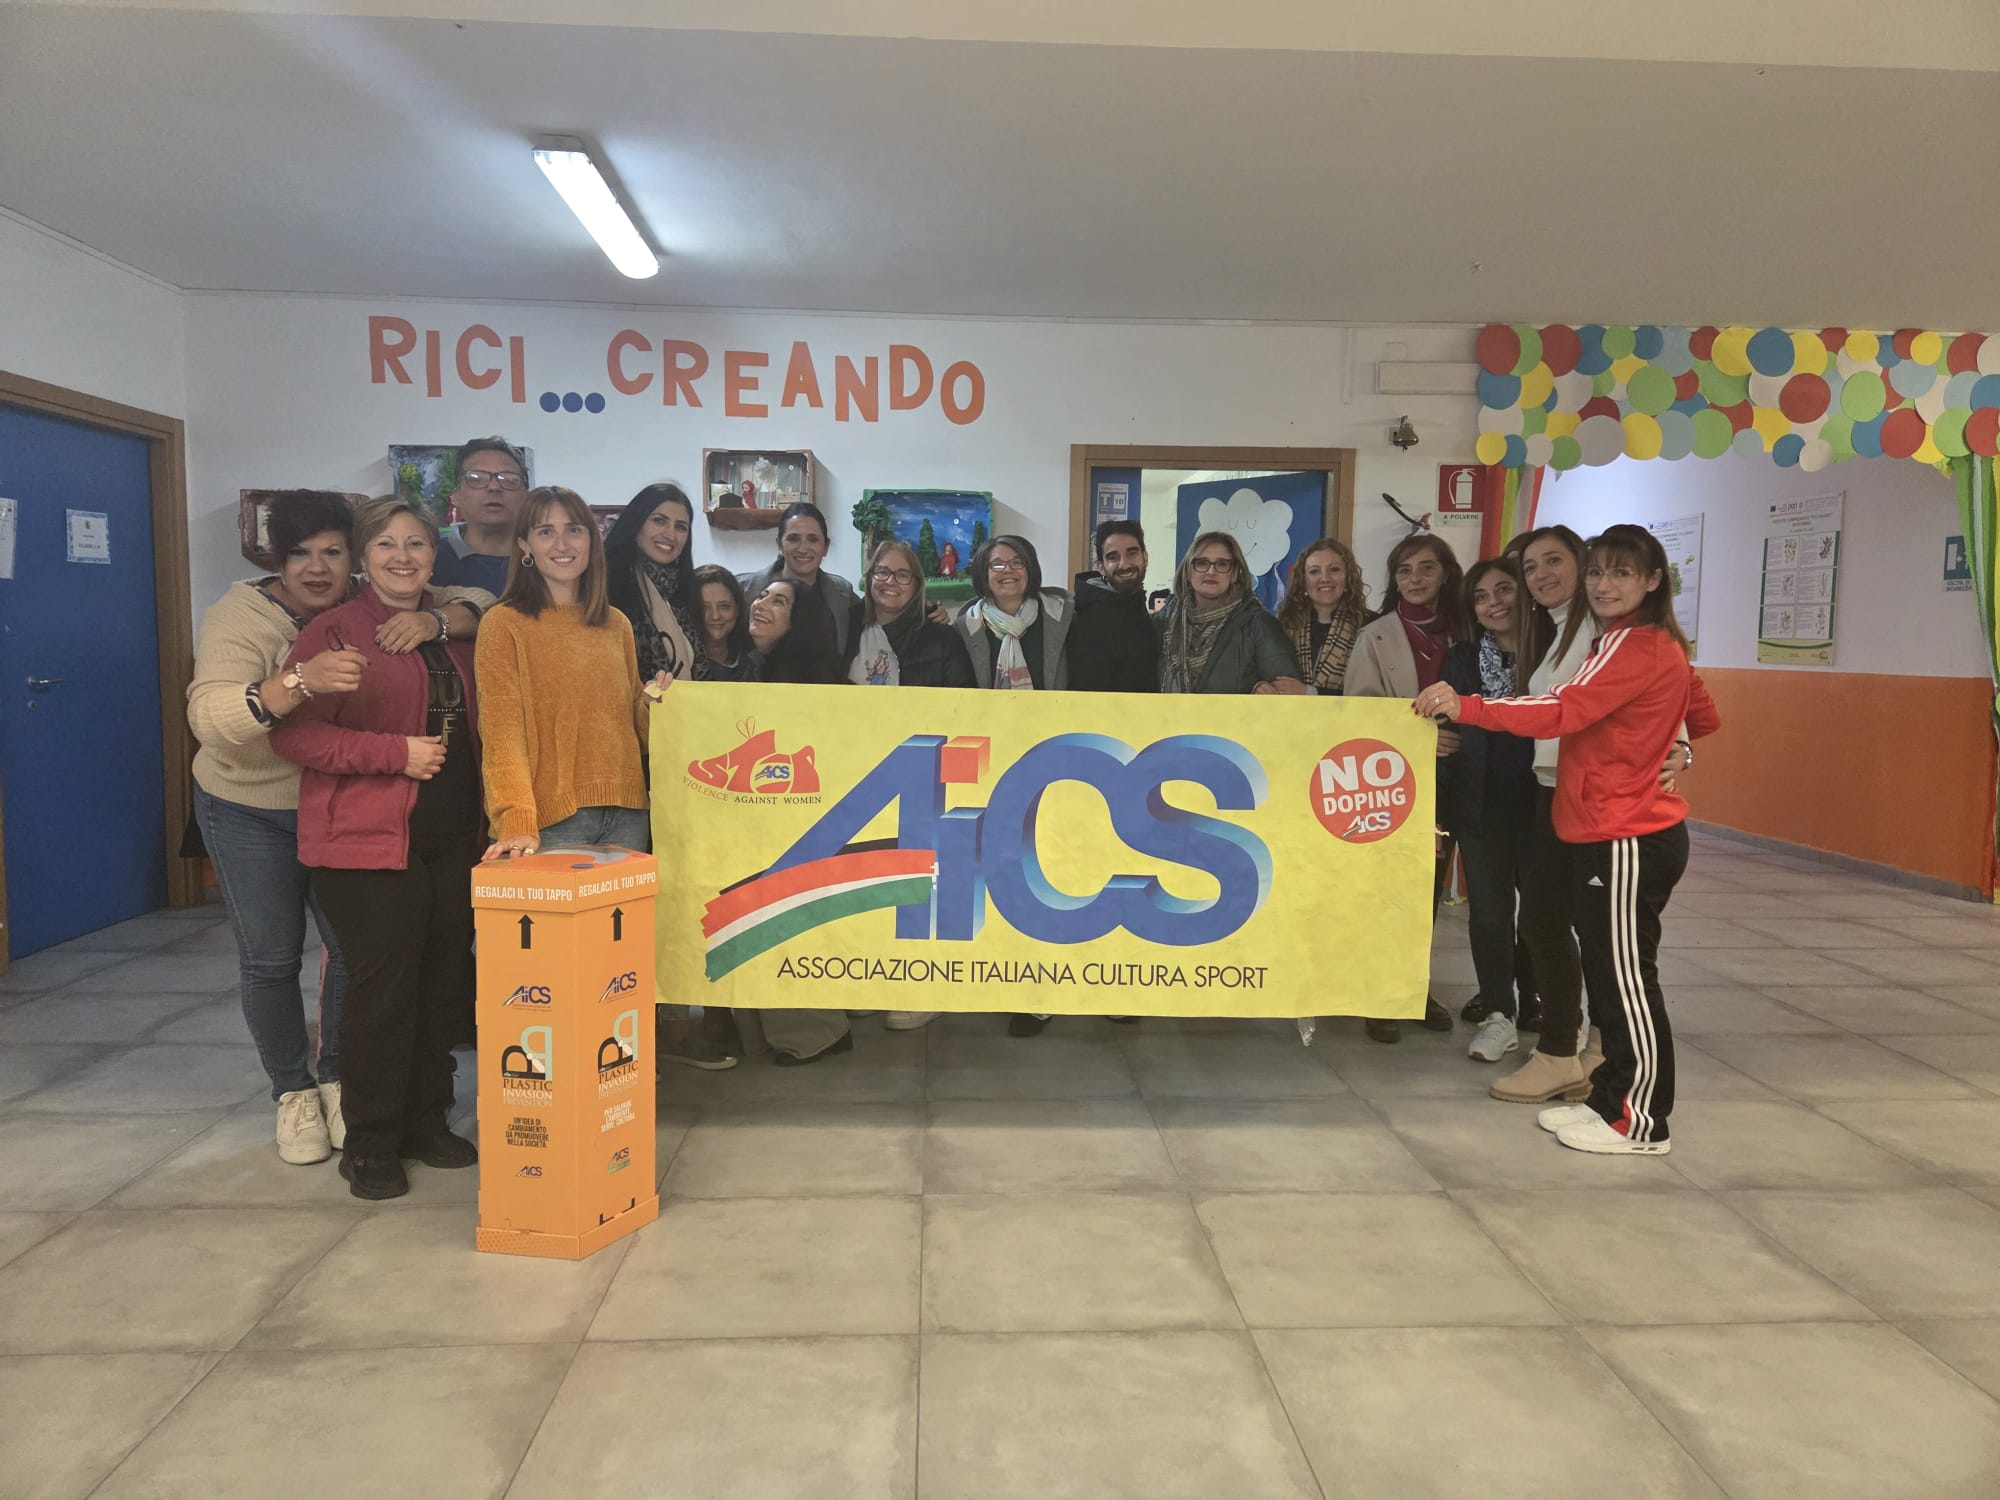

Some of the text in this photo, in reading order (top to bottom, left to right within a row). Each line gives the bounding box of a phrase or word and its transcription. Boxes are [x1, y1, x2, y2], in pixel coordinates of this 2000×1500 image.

[1318, 750, 1406, 794] NO
[682, 775, 822, 805] VIOLENCE AGAINST WOMEN
[1323, 787, 1406, 815] DOPING
[475, 886, 573, 902] REGALACI IL TUO TAPPO
[578, 871, 656, 897] REGALACI IL TUO TAPPO
[777, 956, 1269, 989] ASSOCIAZIONE ITALIANA CULTURA SPORT
[598, 1071, 639, 1093] INVASION
[599, 1060, 639, 1084] PLASTIC
[503, 1078, 553, 1092] PLASTIC
[503, 1088, 553, 1100] INVASION
[508, 1124, 547, 1134] CAMBIAMENTO
